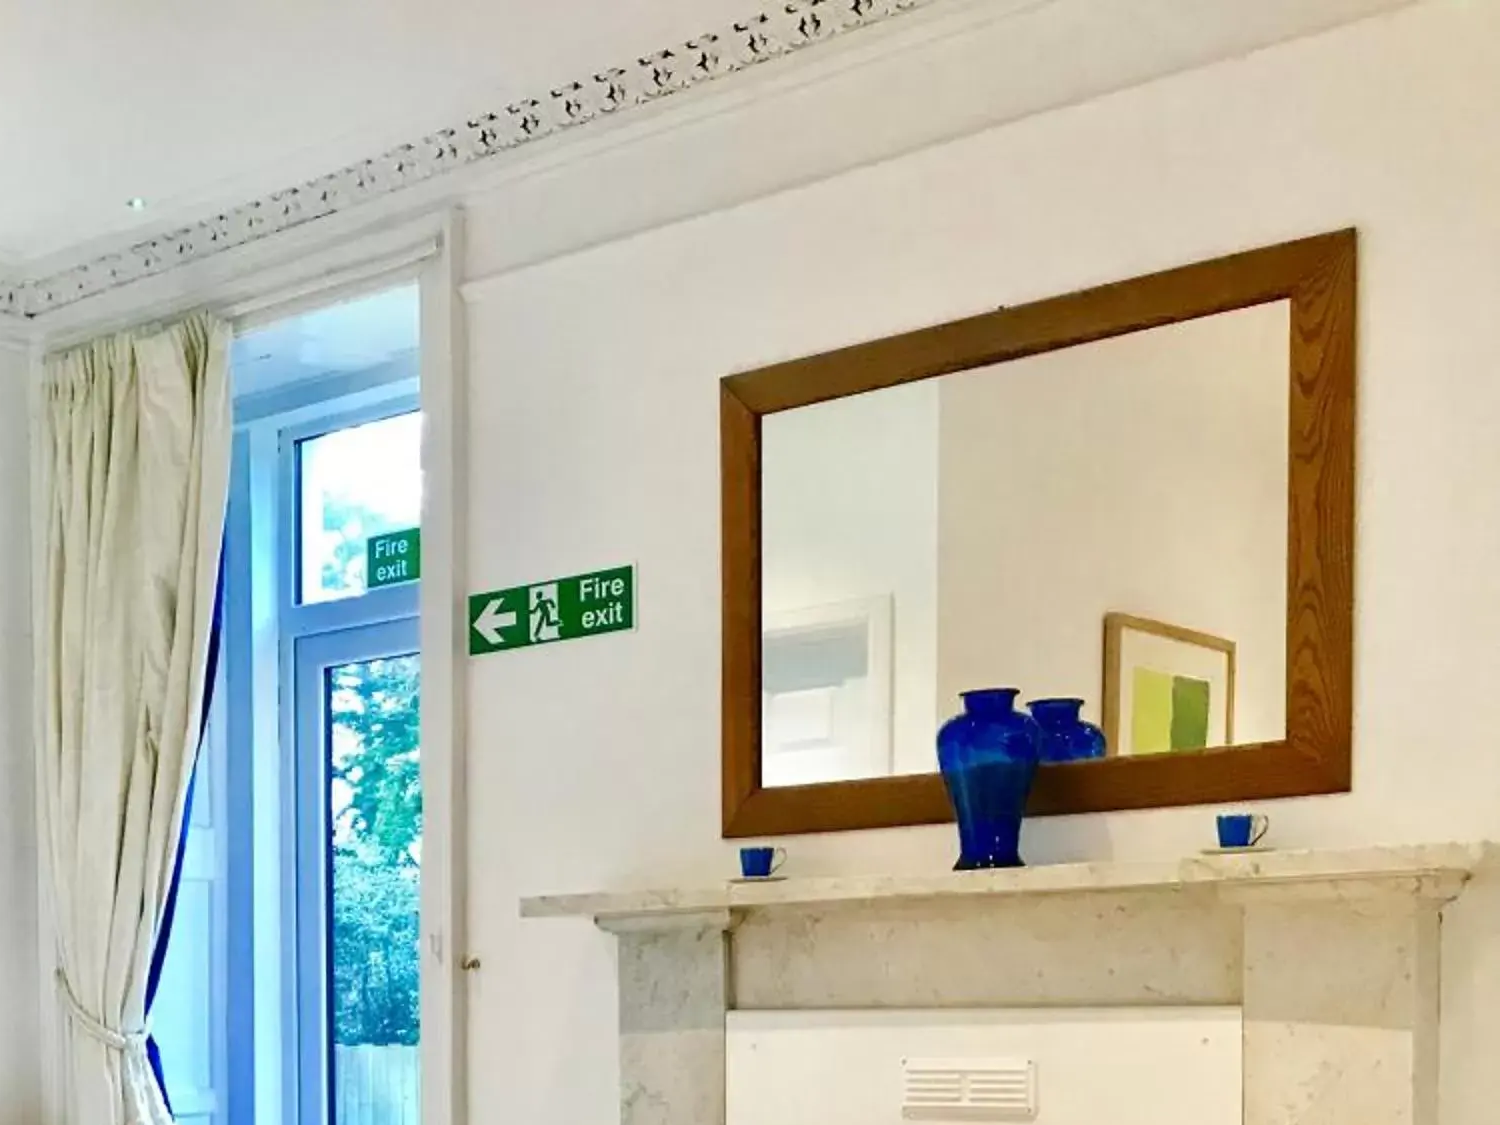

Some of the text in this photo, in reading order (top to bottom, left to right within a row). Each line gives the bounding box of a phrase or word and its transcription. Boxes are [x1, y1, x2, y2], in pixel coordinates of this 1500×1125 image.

[375, 538, 408, 559] Fire
[376, 559, 407, 581] exit
[579, 577, 624, 602] Fire
[581, 602, 623, 629] exit
